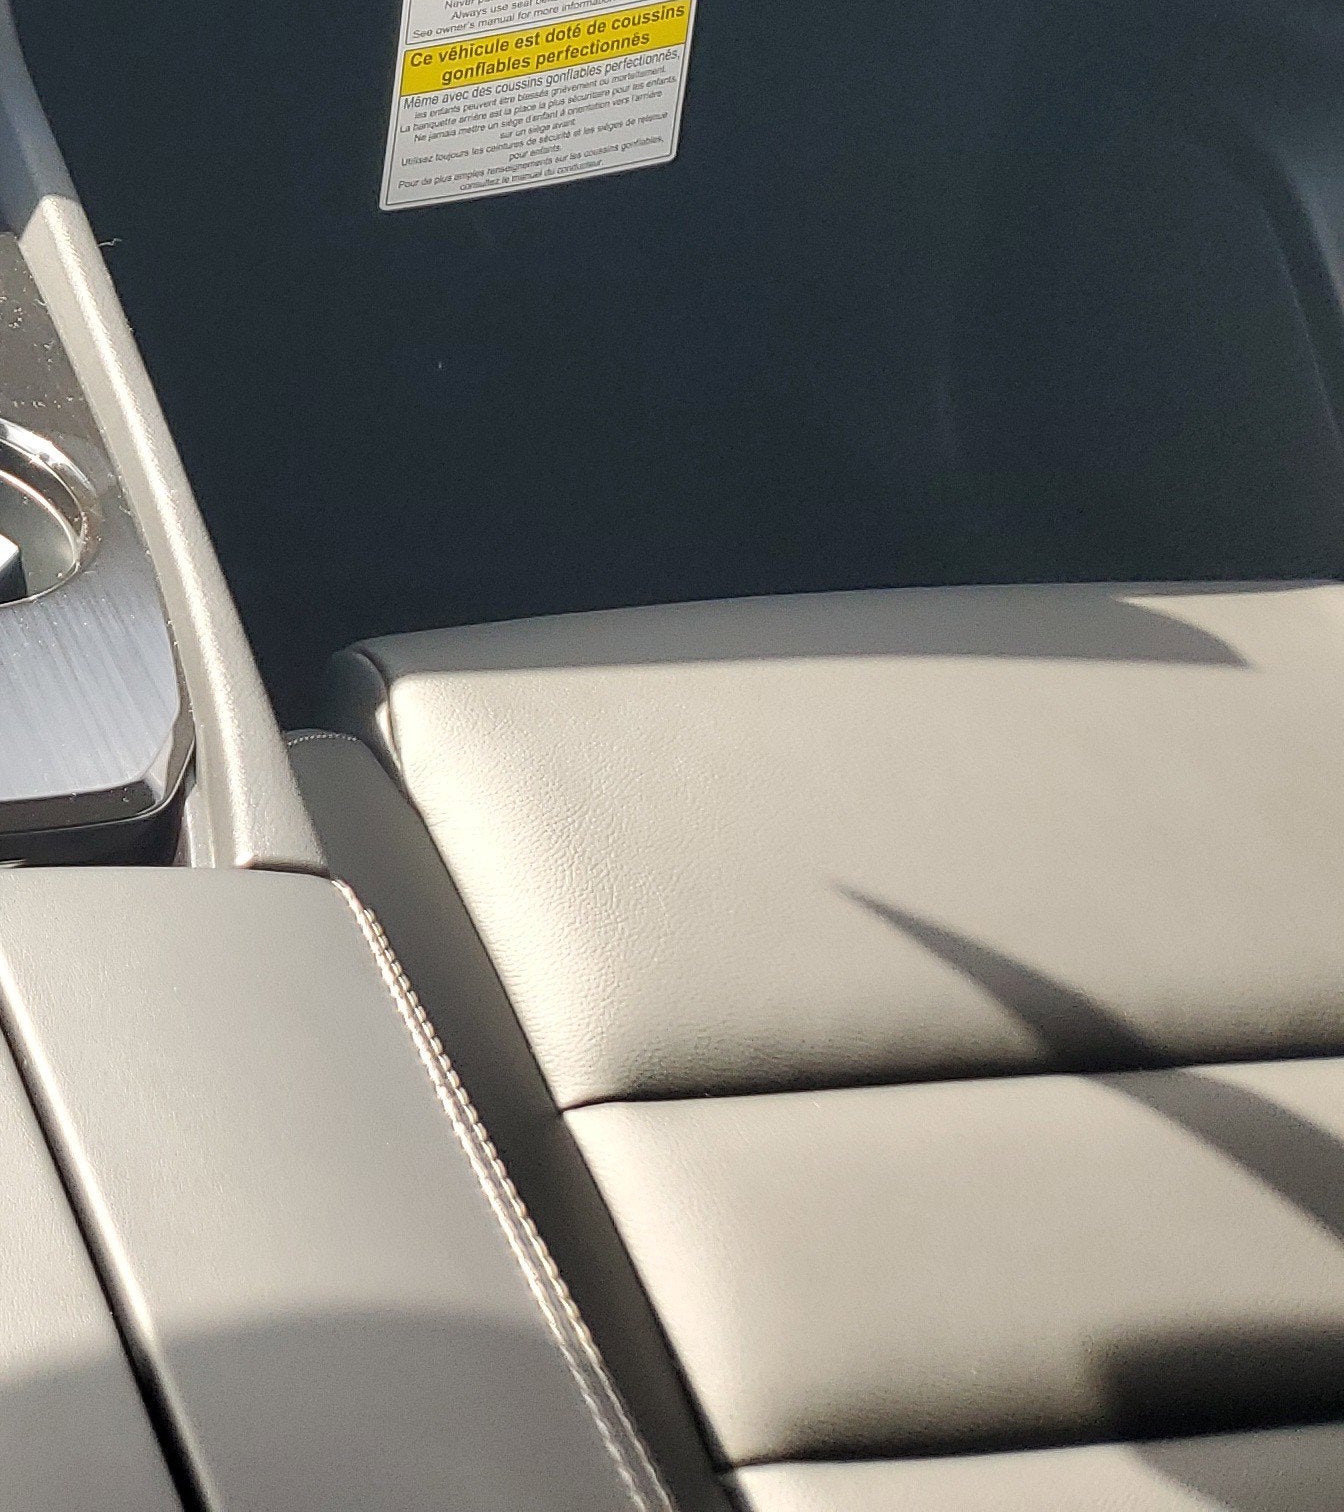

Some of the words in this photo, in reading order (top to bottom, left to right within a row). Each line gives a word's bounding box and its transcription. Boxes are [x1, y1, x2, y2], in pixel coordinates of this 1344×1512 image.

[410, 52, 433, 67] Ce
[438, 38, 510, 62] véhicule
[514, 31, 541, 48] est
[545, 23, 582, 43] doté
[586, 19, 607, 35] de
[611, 5, 685, 30] coussins
[441, 56, 531, 85] gonflables
[535, 33, 650, 69] perfectionnés
